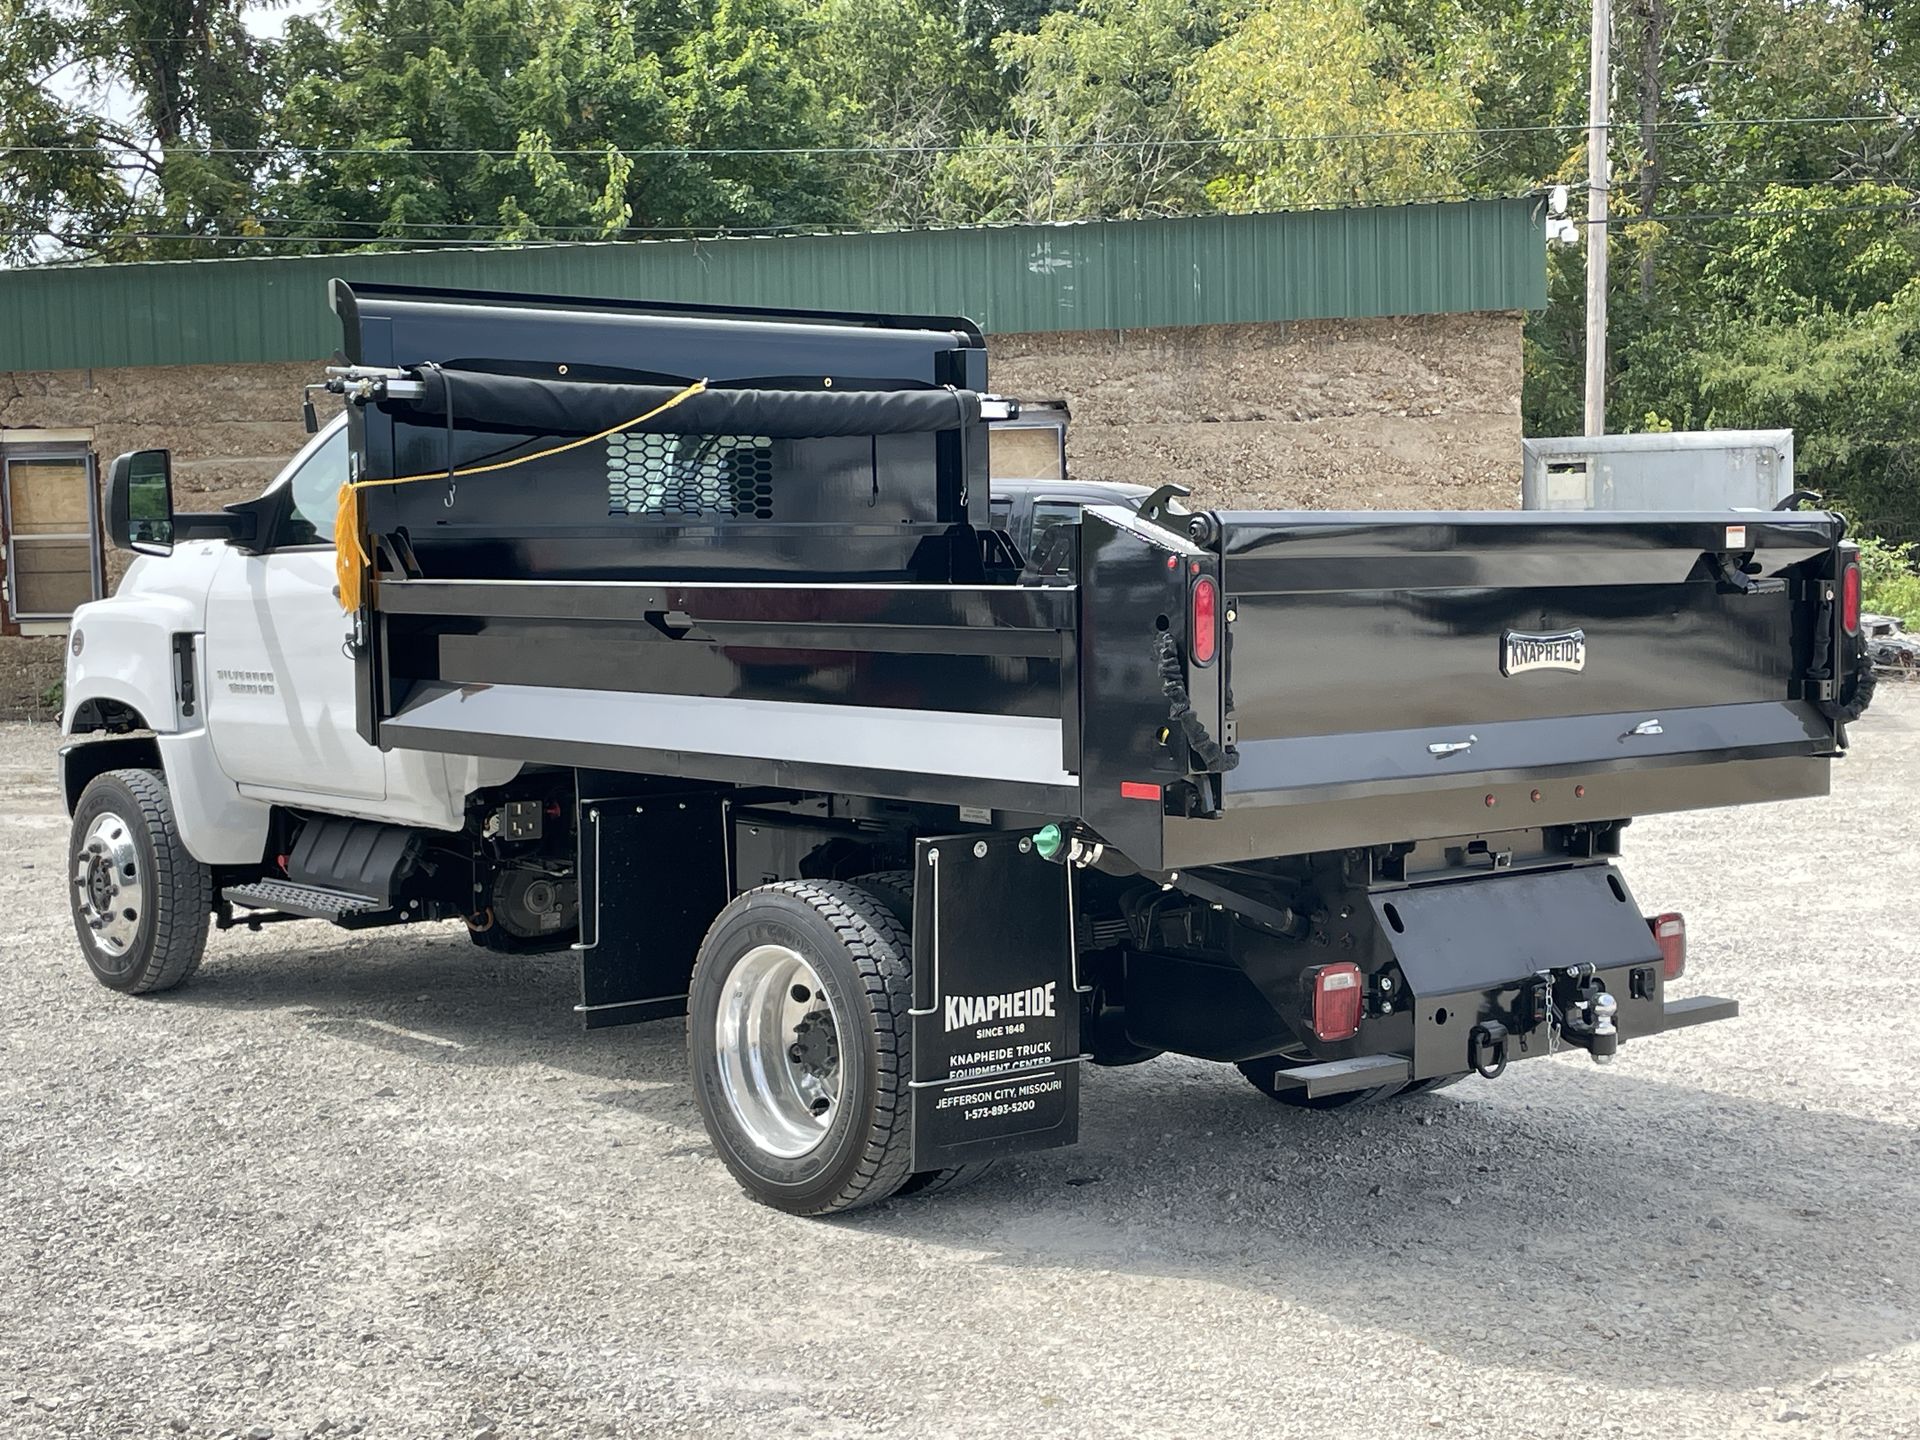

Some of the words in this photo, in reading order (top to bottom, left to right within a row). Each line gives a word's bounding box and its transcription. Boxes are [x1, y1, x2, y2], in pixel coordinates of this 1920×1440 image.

[1511, 637, 1580, 667] KNAPHEIDE
[944, 981, 1056, 1033] KNAPHEIDE
[976, 1025, 1004, 1039] SINCE
[1005, 1023, 1025, 1036] 1848
[949, 1047, 1014, 1067] KNAPHEIDE
[1016, 1041, 1052, 1057] TRUCK
[935, 1091, 992, 1109] JEFFERSON
[994, 1088, 1017, 1101] CITY,
[1018, 1080, 1062, 1096] MISSOURI
[964, 1100, 1035, 1120] 1-573-893-5200
